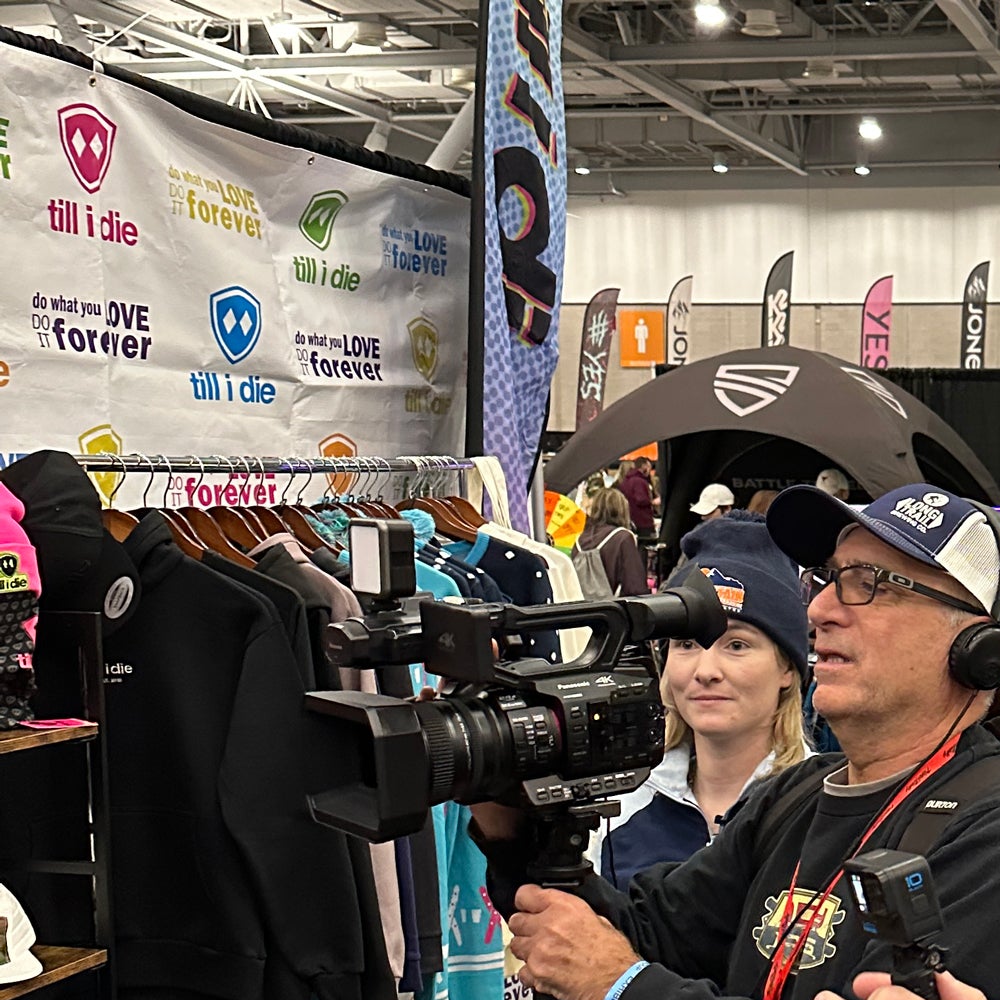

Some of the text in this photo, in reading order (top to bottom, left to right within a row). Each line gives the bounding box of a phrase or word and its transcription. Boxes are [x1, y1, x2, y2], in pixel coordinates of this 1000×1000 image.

[217, 179, 259, 215] LOVE
[48, 199, 139, 246] till i die
[186, 189, 262, 240] forever
[414, 229, 448, 255] LOVE
[293, 256, 361, 292] till i die
[391, 244, 448, 277] forever
[32, 292, 47, 309] do
[50, 294, 79, 314] what
[81, 302, 101, 319] you
[32, 314, 50, 331] DO
[965, 303, 984, 370] JONE
[37, 332, 50, 348] IT
[295, 331, 380, 359] do what you LOVE
[310, 351, 384, 382] forever
[190, 371, 277, 405] till i die
[184, 477, 278, 508] forever
[899, 503, 933, 528] TRAIL
[907, 497, 940, 520] LONG
[110, 662, 133, 675] die
[557, 675, 615, 690] Panasonic 4K
